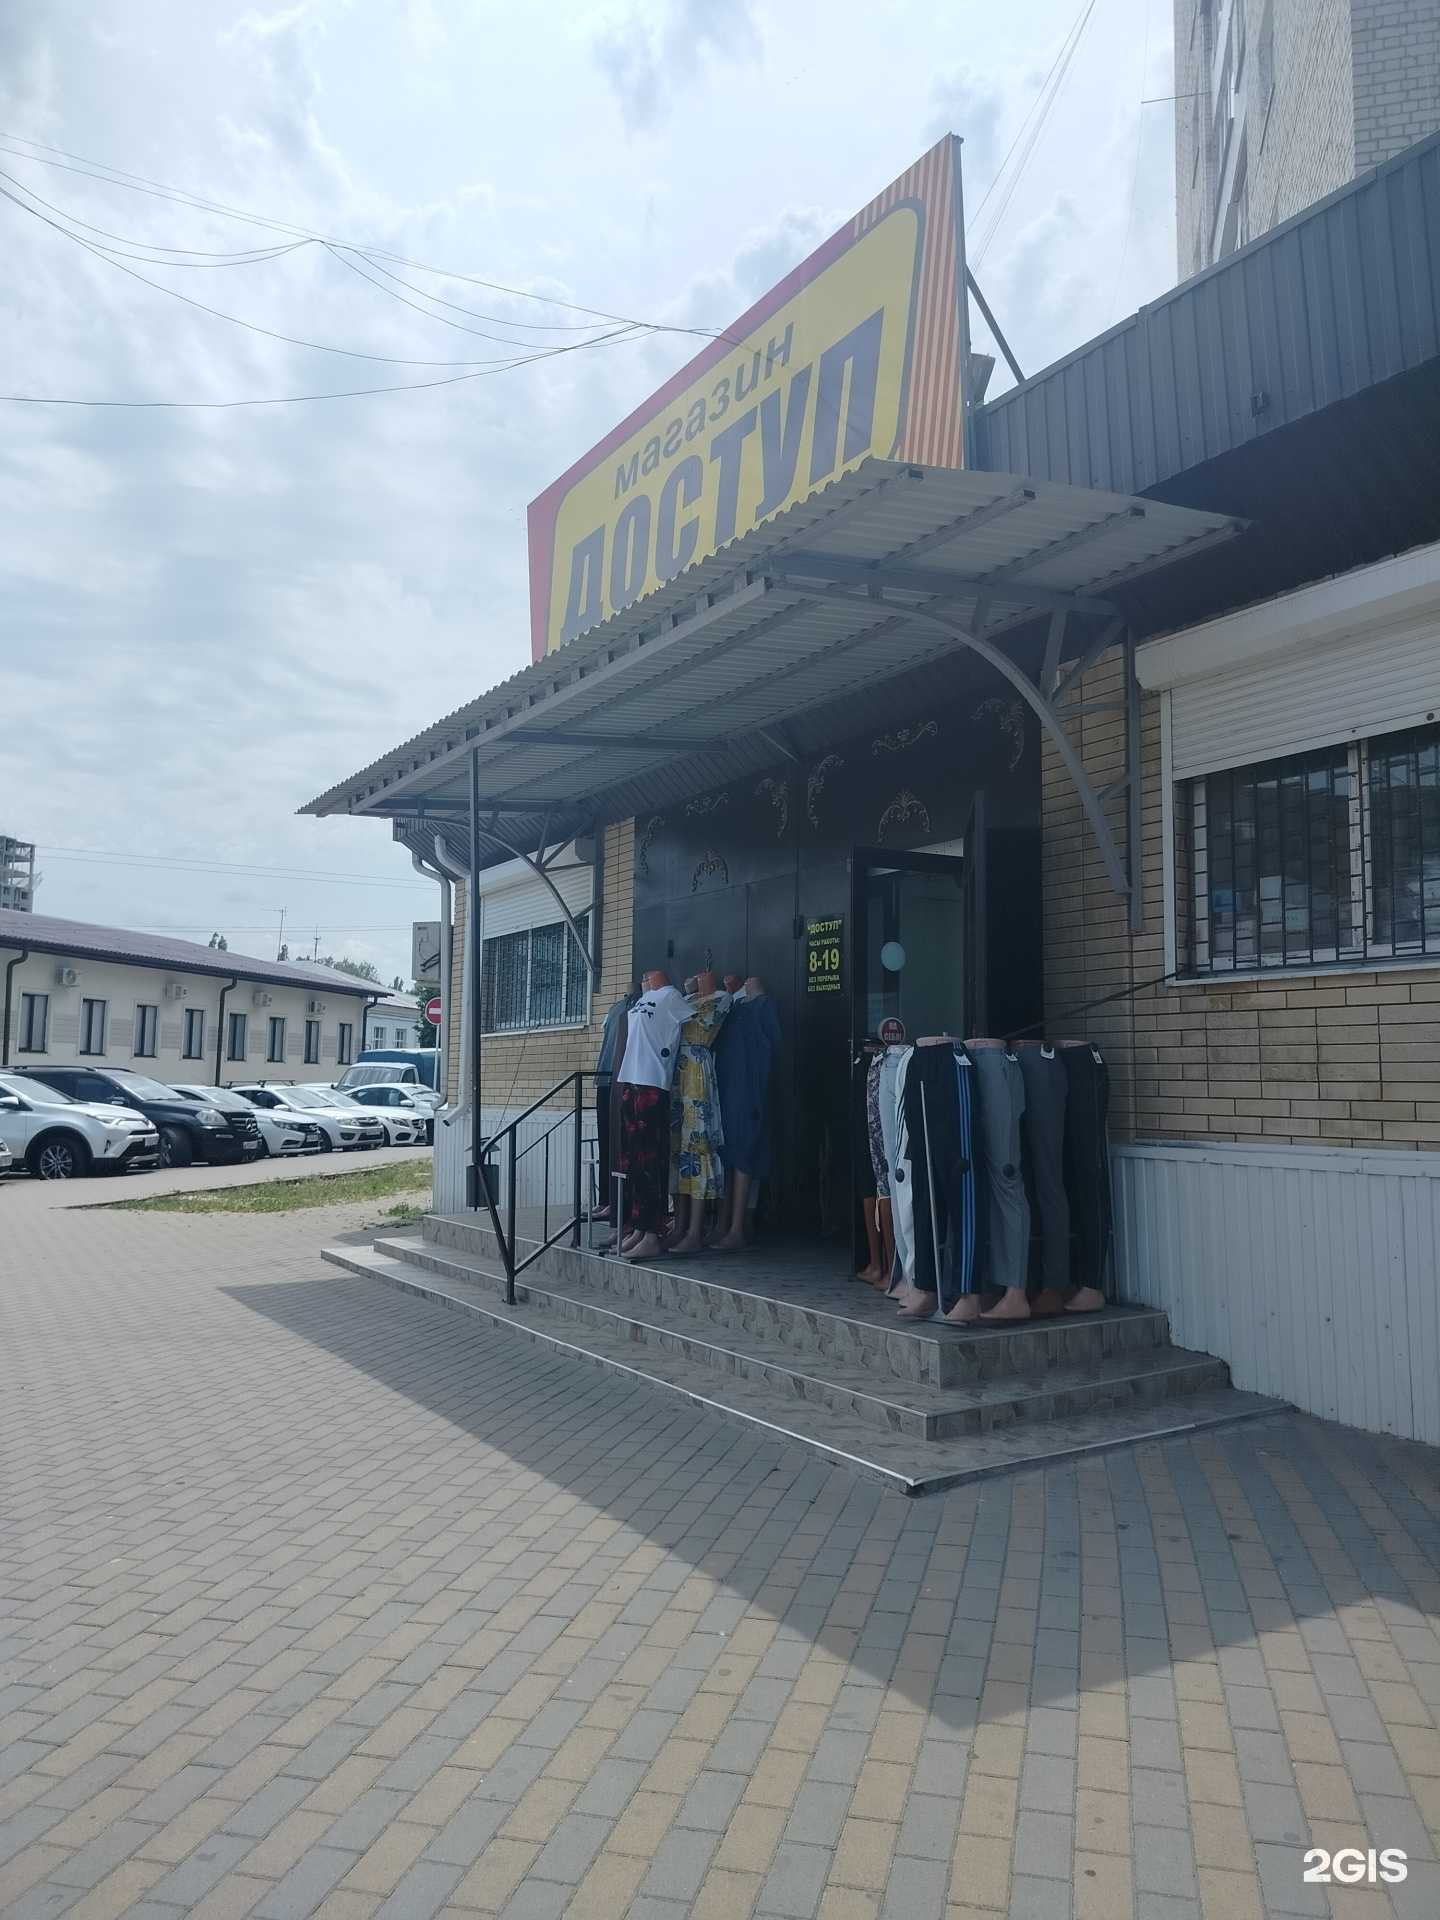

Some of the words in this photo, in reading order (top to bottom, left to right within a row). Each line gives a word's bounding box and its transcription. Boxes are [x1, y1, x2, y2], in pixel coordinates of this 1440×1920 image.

[560, 306, 884, 637] ДОСТУП
[614, 322, 794, 499] магазин
[809, 948, 840, 973] 8-19
